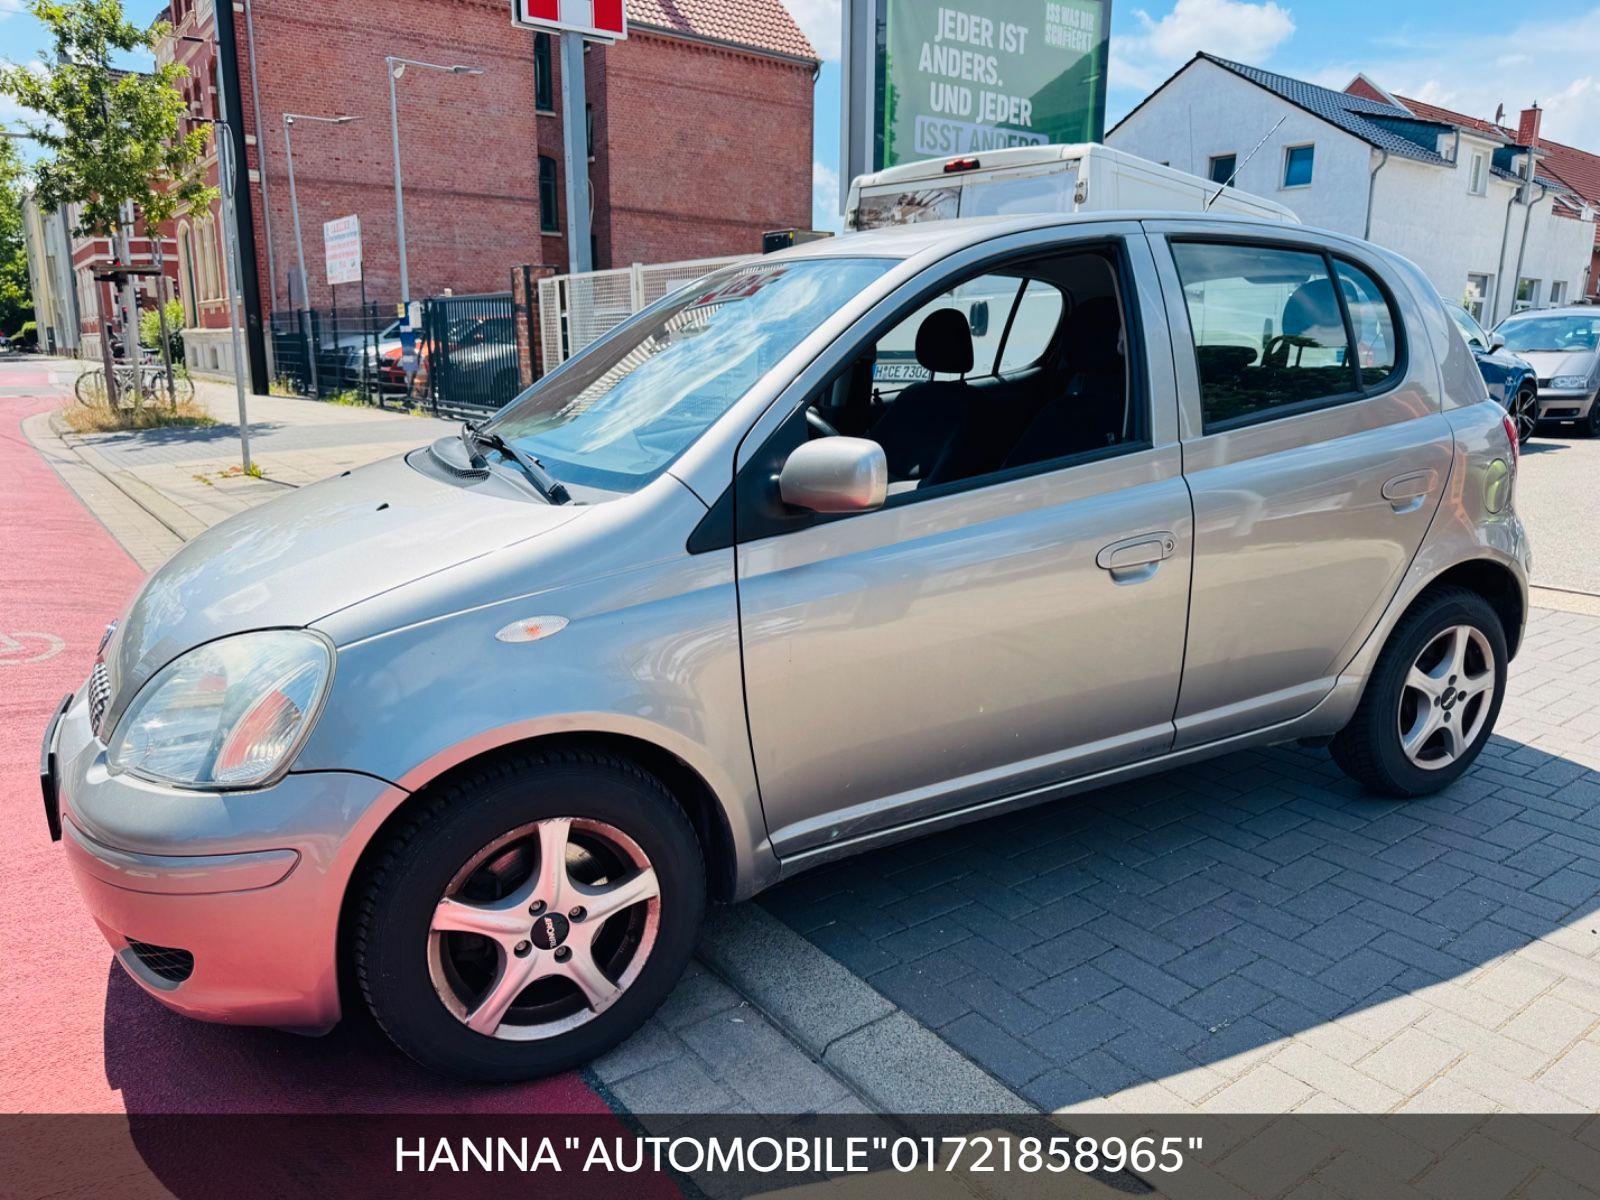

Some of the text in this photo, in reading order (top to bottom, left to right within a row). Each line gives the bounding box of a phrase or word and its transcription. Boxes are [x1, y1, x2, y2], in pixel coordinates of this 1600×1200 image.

[934, 7, 1029, 55] JEDER IST
[918, 42, 1003, 87] ANDERS.
[930, 82, 1033, 128] UND JEDER
[919, 120, 1040, 153] ISST ANDE
[875, 365, 883, 379] H
[888, 366, 902, 378] CE
